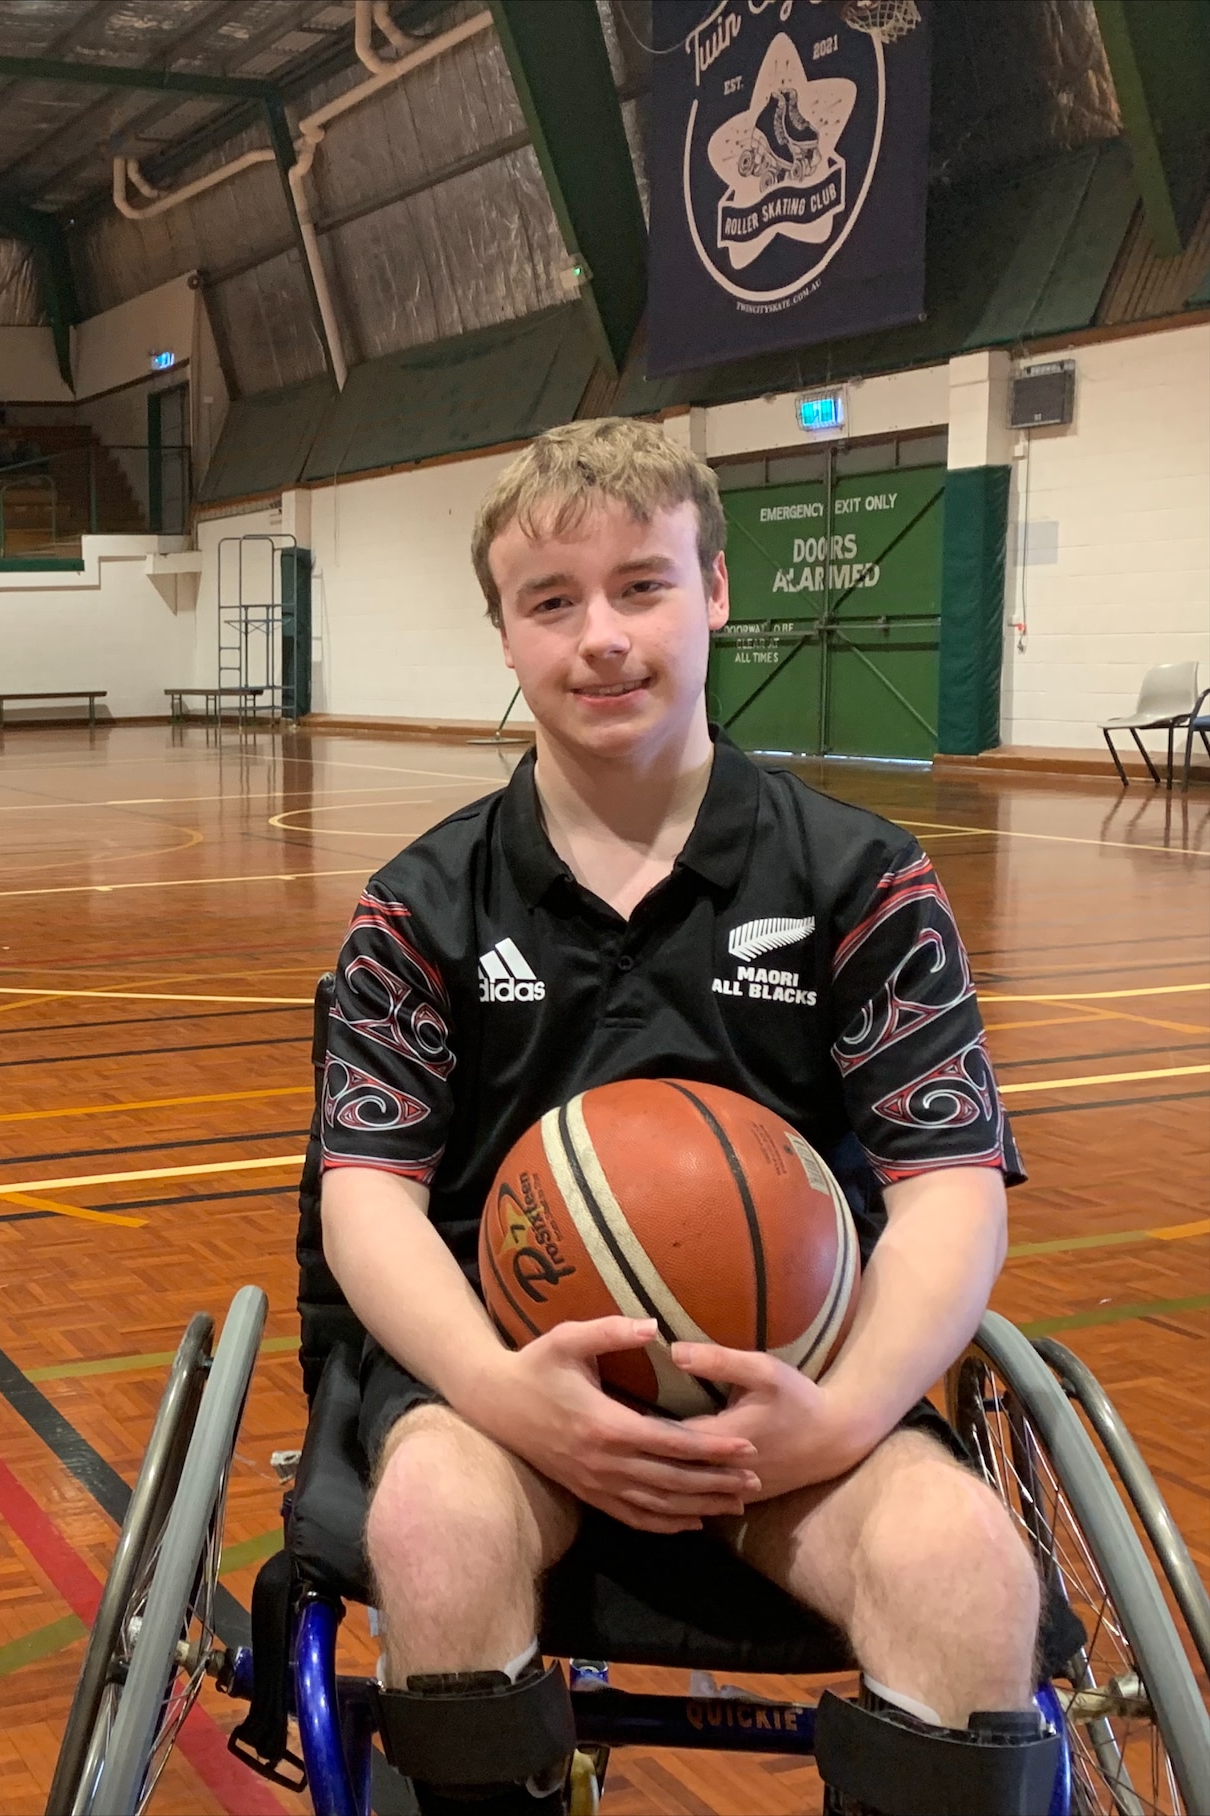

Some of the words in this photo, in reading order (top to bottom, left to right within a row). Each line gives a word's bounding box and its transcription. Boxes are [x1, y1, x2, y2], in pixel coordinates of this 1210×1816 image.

[685, 0, 741, 86] Twin
[723, 75, 744, 95] EST.
[812, 34, 839, 60] 2021
[725, 212, 759, 235] ROLLER
[761, 198, 806, 222] SKATING
[810, 183, 837, 213] CLUB
[760, 503, 824, 521] EMERGENCY
[835, 497, 861, 514] EXIT
[865, 493, 898, 511] ONLY
[793, 534, 857, 563] DOORS
[773, 562, 880, 592] ALARMED
[736, 638, 766, 649] CLEAR
[767, 637, 780, 649] AT
[734, 652, 751, 663] ALL
[753, 652, 779, 663] TIMES
[478, 977, 546, 1002] didas
[737, 966, 799, 987] MAORI
[712, 978, 743, 996] ALL
[749, 983, 817, 1006] BLACKS
[686, 1701, 798, 1731] QUICKIE
